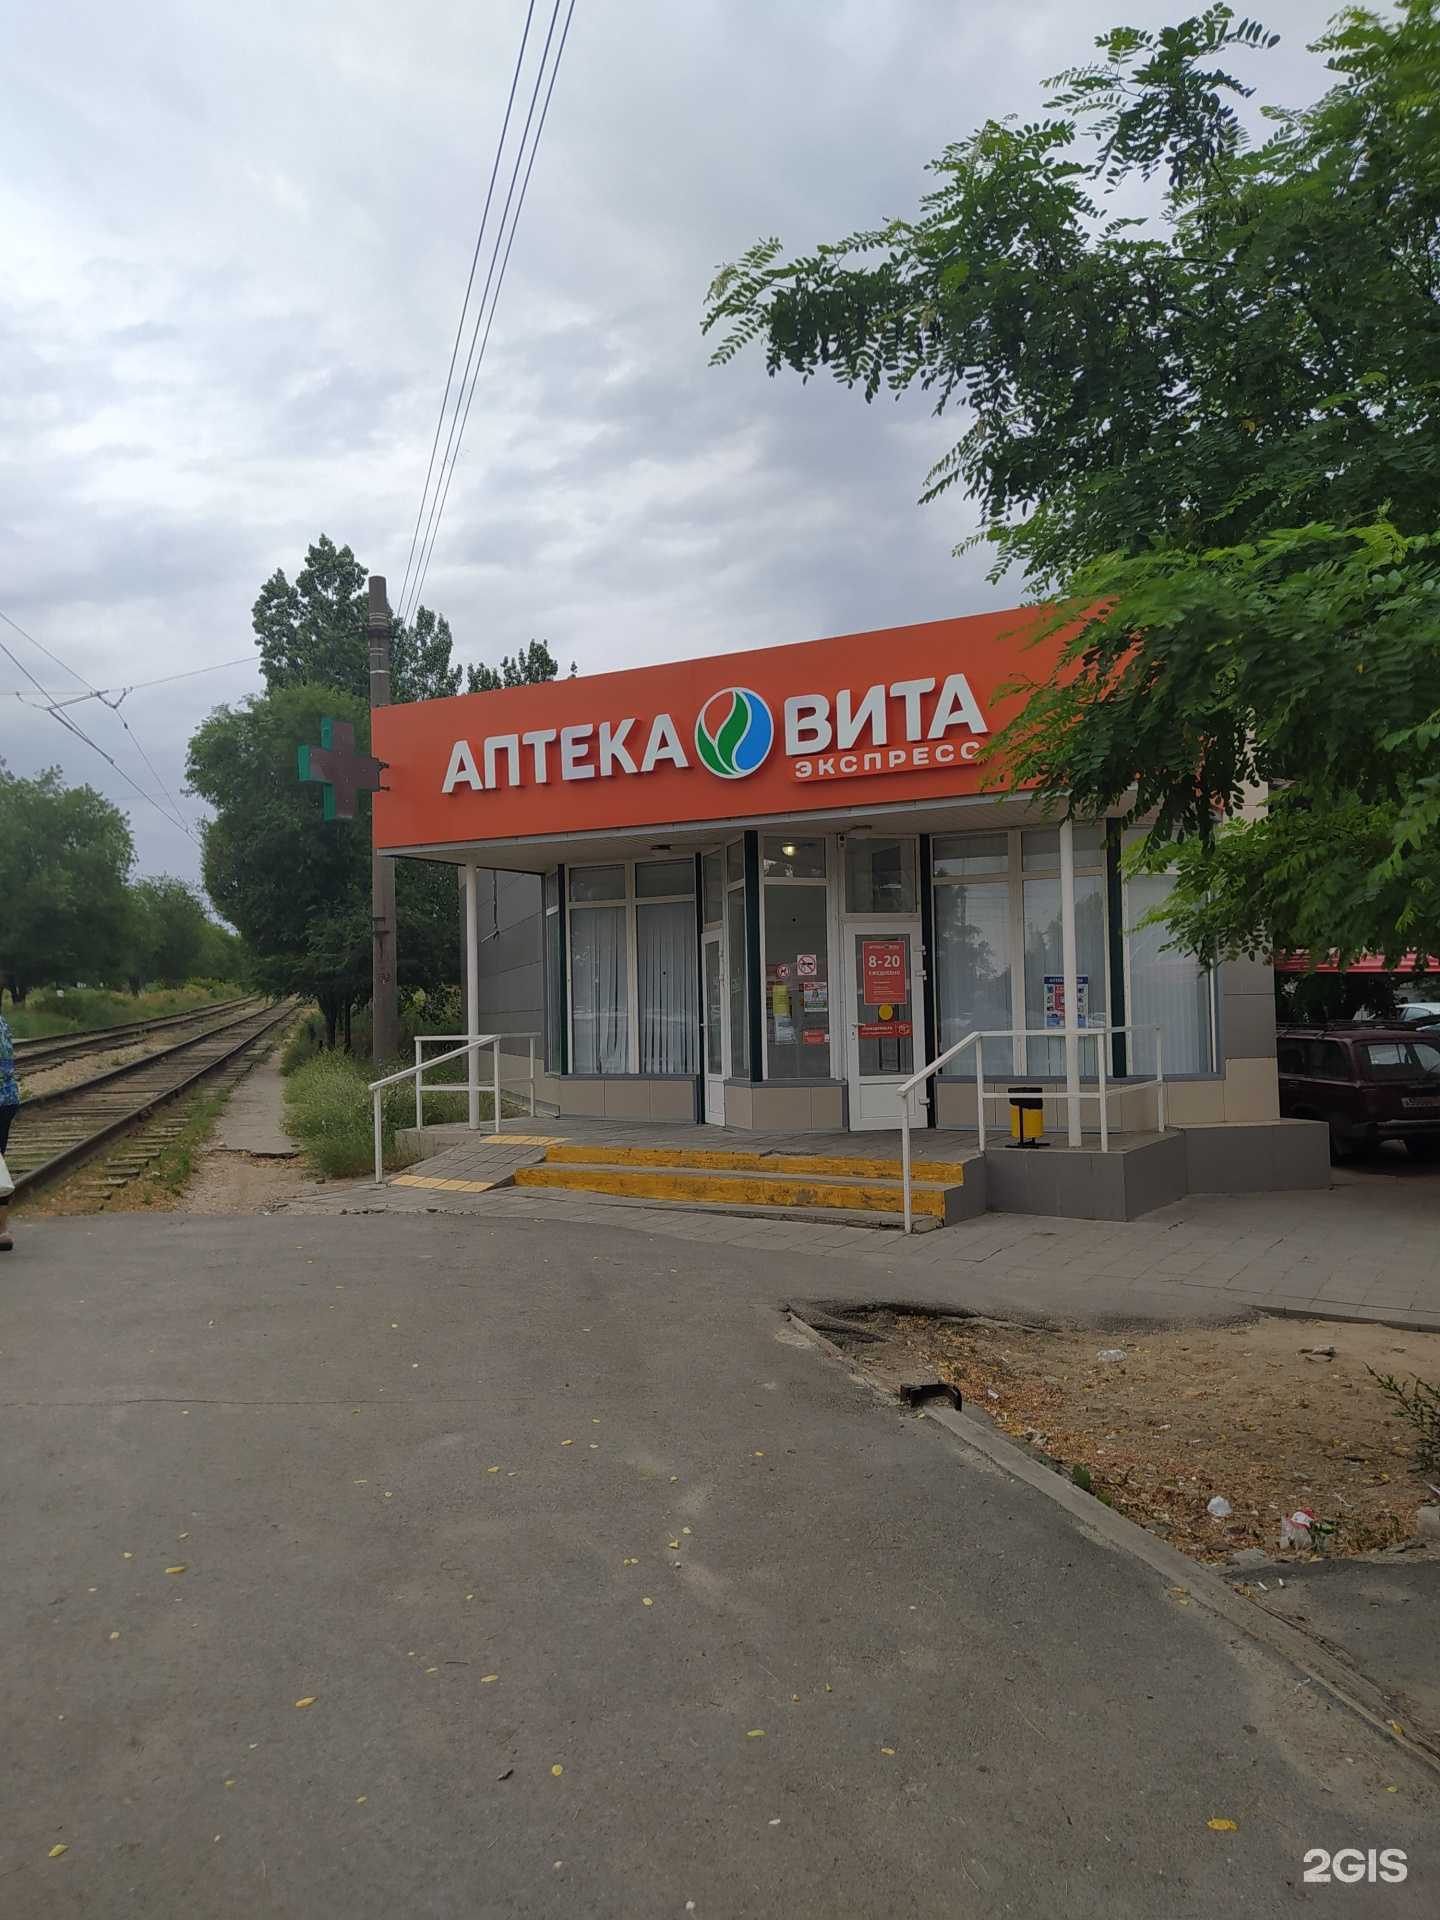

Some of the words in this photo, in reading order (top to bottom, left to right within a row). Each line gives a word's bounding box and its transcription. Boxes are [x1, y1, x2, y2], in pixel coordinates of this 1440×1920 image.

[442, 714, 689, 793] АПТЕКА
[784, 673, 988, 755] ВИТА
[795, 741, 981, 778] ЭКСПРЕСС
[868, 955, 900, 968] 8-20
